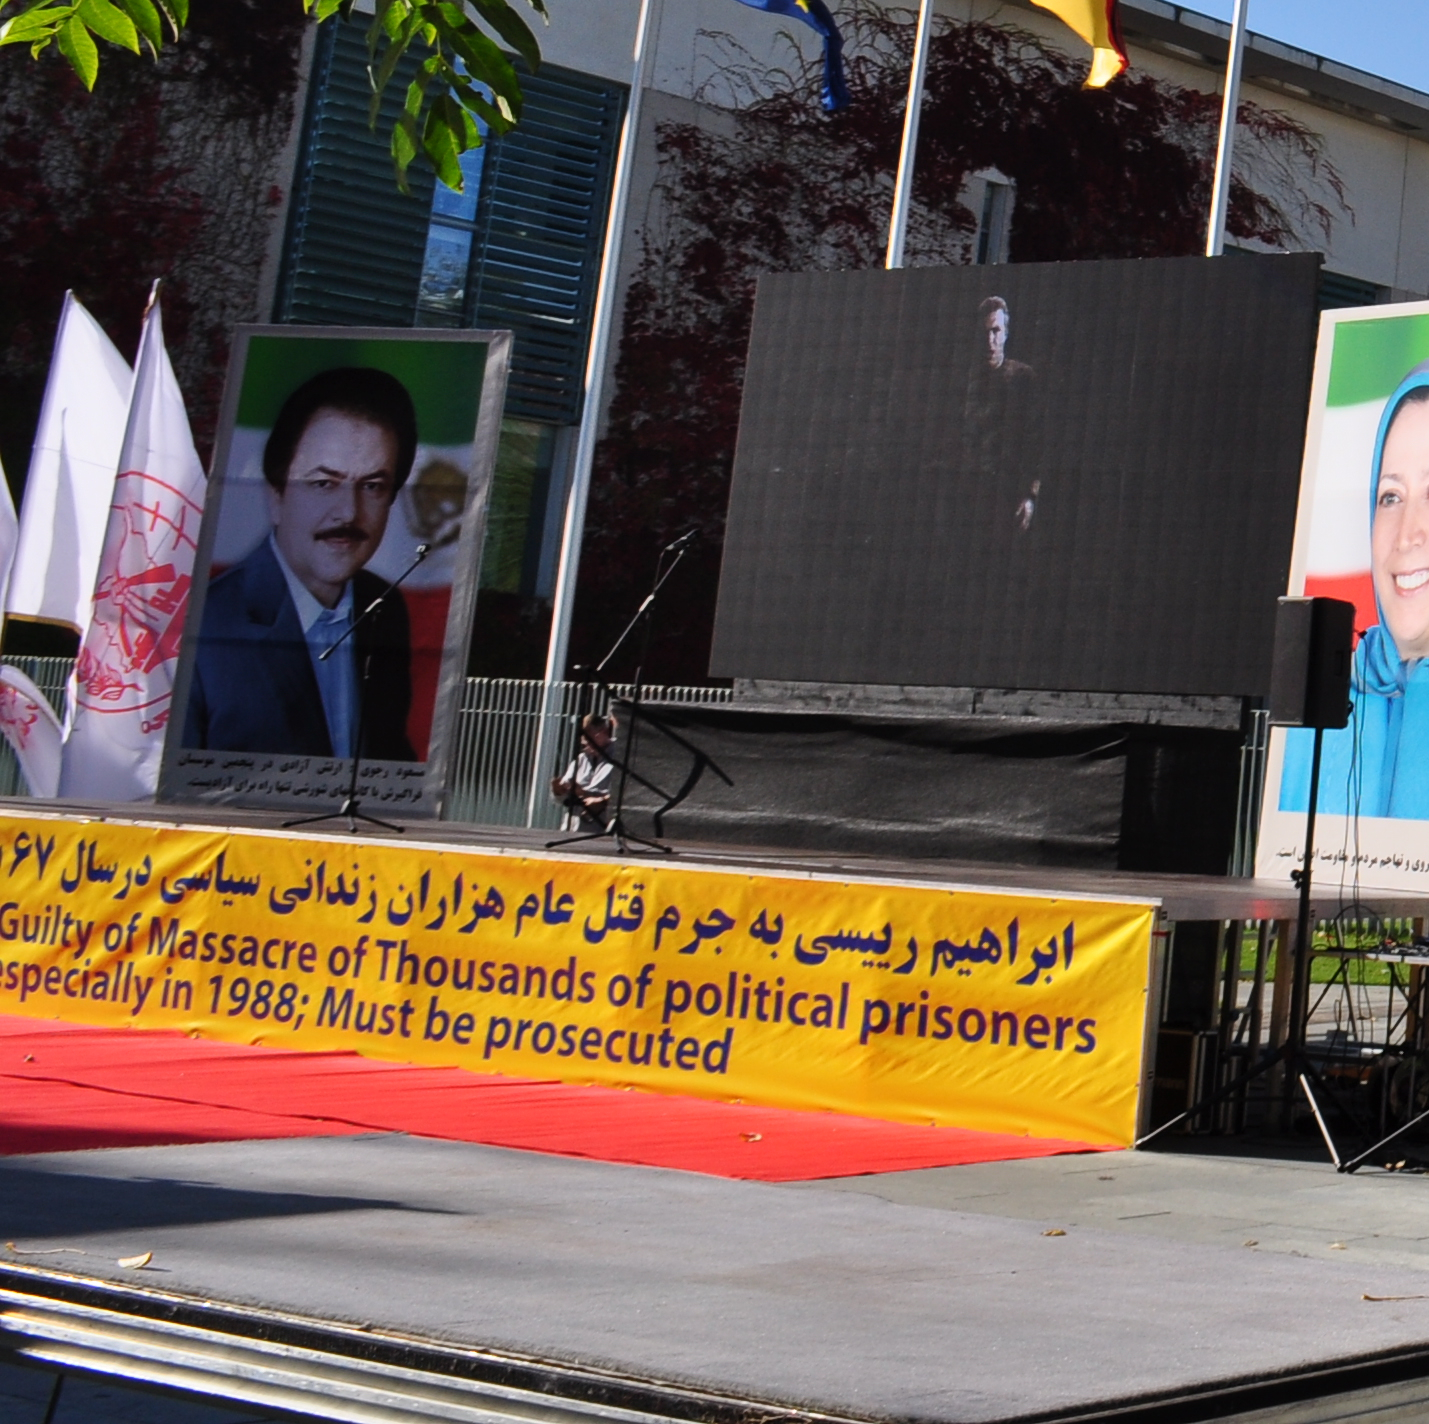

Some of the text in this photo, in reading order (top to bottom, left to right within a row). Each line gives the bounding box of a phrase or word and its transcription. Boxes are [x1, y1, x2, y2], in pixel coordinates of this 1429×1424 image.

[160, 848, 261, 906] سیاسی
[268, 858, 378, 924] زندانی
[387, 868, 506, 934] هزاران
[514, 879, 575, 938] عام
[583, 882, 645, 944] قتل
[654, 905, 736, 955] جرم
[749, 908, 784, 959] به
[0, 901, 1097, 1054] Guilty of Massacre of Thousands of political prisoners
[930, 916, 1075, 986] ابراهیم
[160, 966, 193, 1010] in
[209, 975, 310, 1031] 1988;
[316, 985, 415, 1038] Must
[423, 995, 476, 1044] be
[483, 1015, 734, 1074] prosecuted
